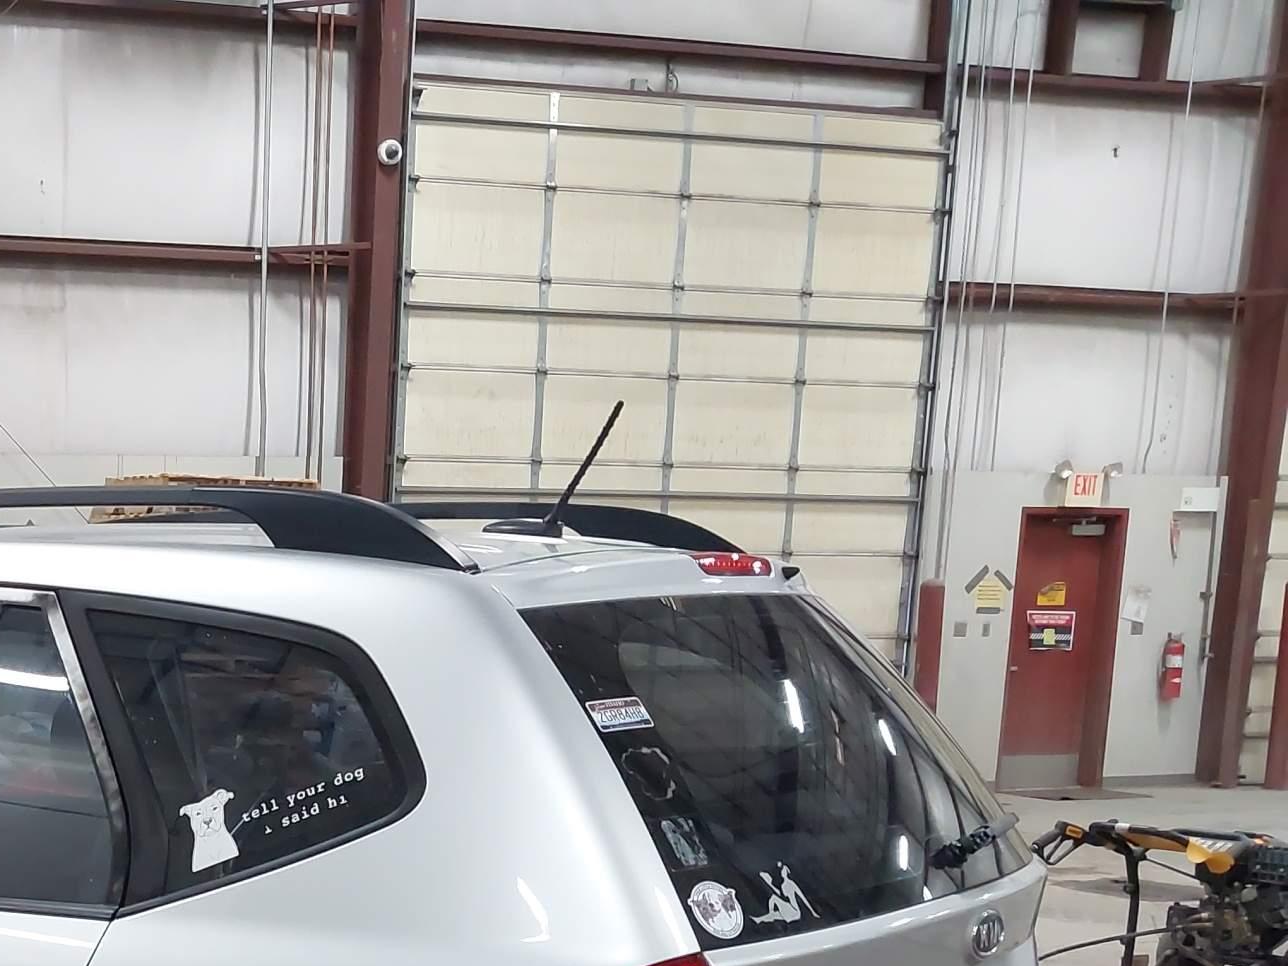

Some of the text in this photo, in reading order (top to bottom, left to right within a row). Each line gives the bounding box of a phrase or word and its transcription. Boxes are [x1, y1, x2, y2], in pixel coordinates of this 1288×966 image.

[1074, 474, 1098, 496] EXIT
[242, 767, 364, 822] tell your dog
[281, 803, 320, 827] said
[327, 795, 348, 809] hi
